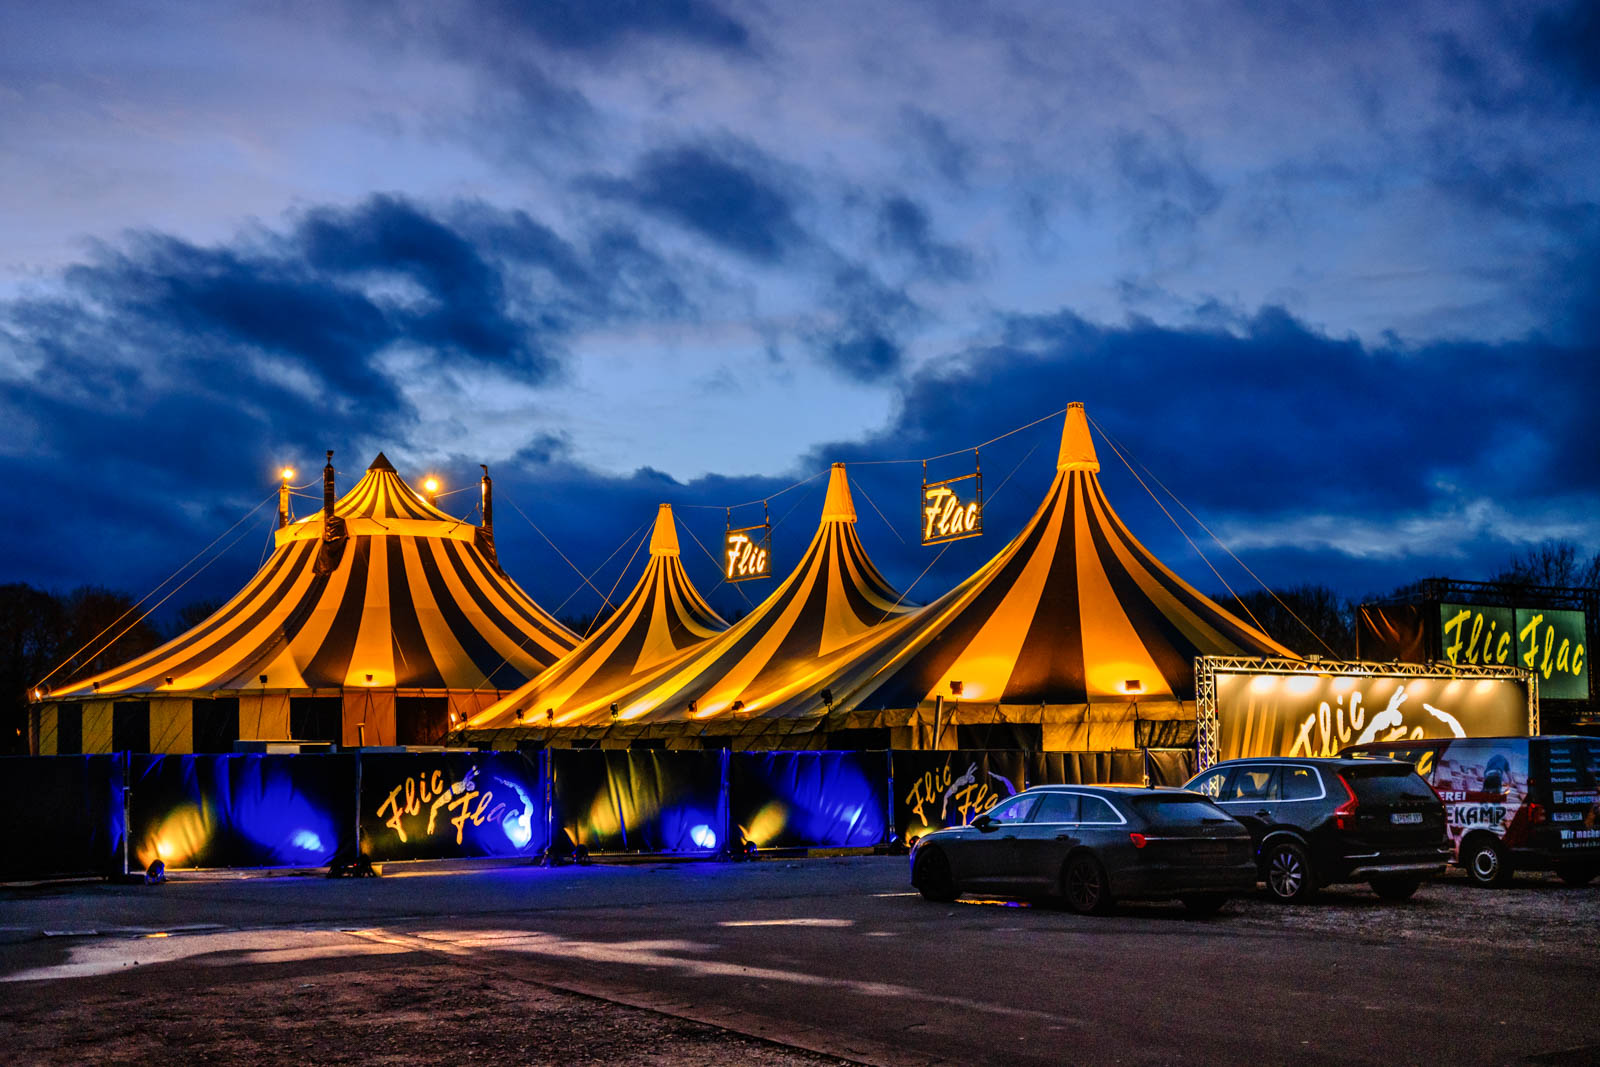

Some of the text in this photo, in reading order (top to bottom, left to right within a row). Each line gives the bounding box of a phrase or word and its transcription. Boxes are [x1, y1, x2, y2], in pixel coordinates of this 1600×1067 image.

[924, 486, 978, 540] Flac
[727, 533, 767, 579] Flic
[1444, 609, 1585, 690] Flic Flac
[376, 768, 445, 844] Flic
[905, 764, 952, 827] Flic
[955, 783, 999, 827] Fla
